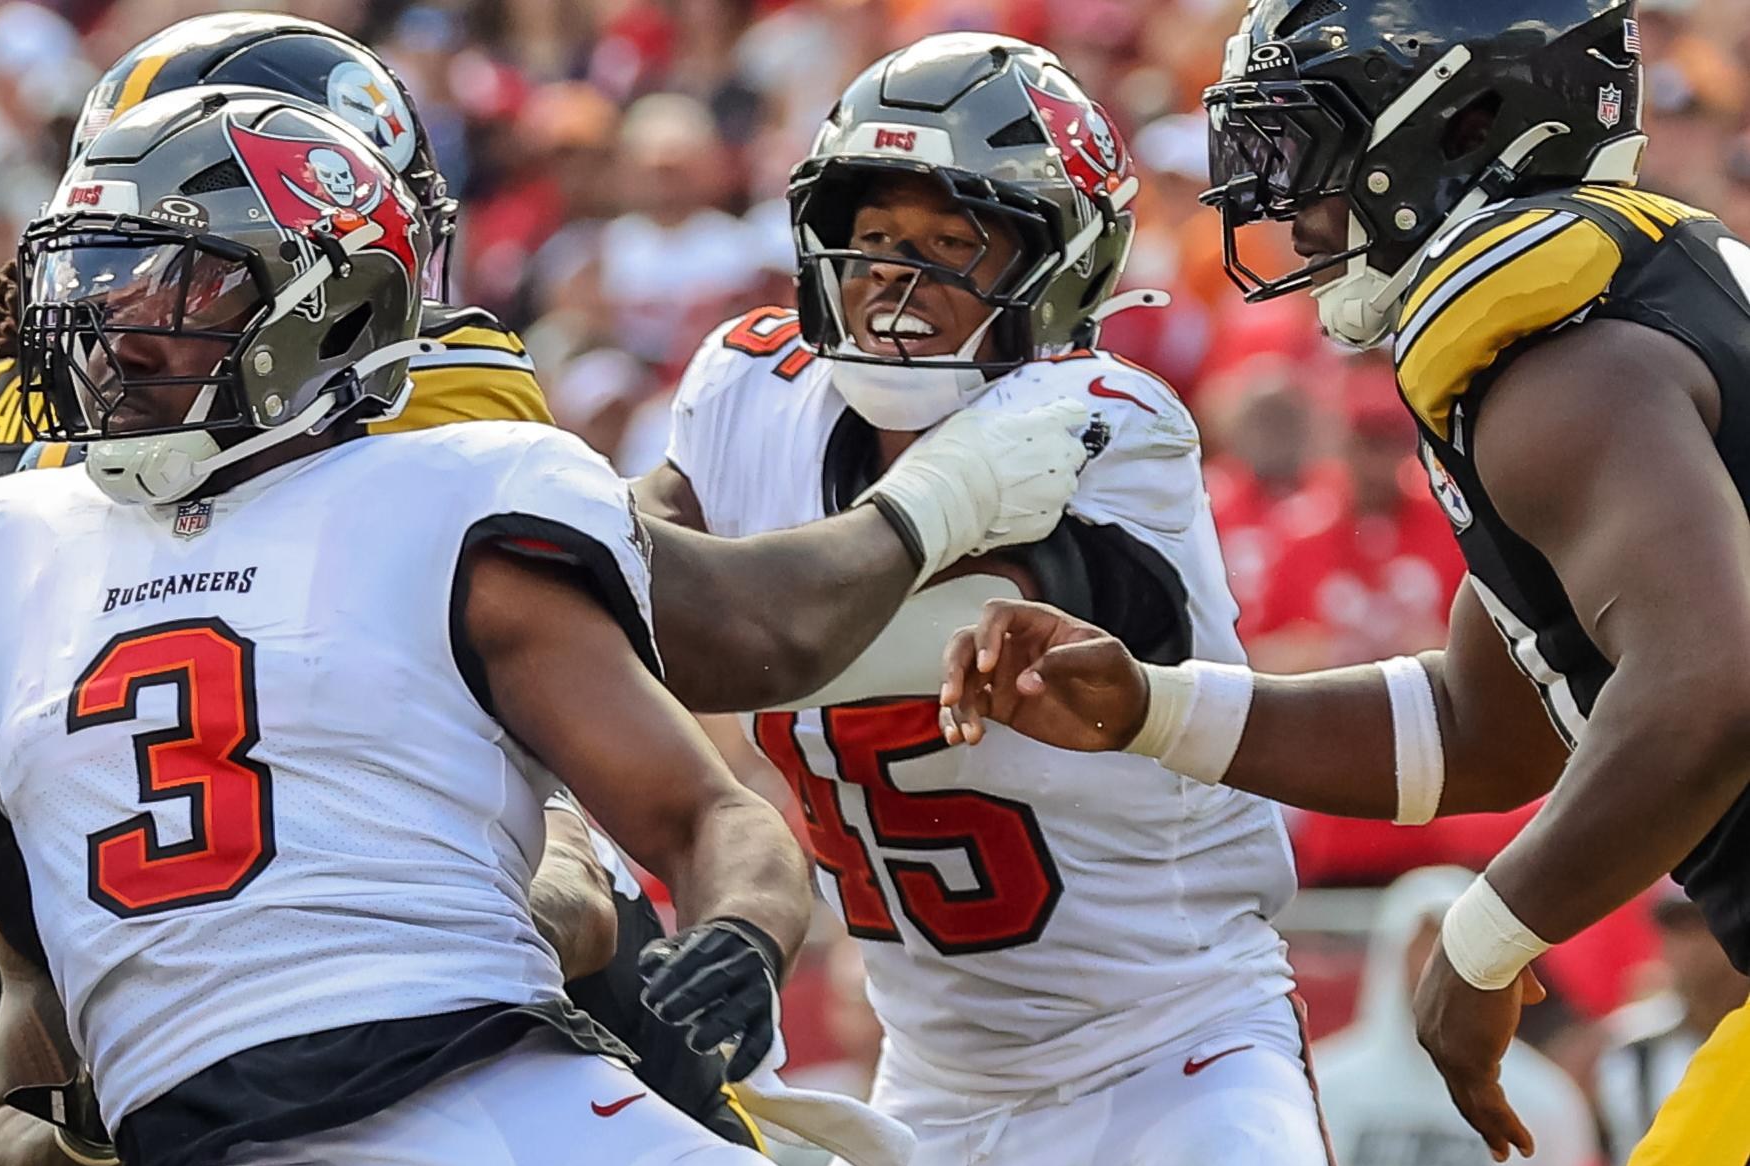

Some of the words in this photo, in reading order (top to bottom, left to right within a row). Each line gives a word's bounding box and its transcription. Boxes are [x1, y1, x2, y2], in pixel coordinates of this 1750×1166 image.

[1248, 57, 1290, 73] OAKLEY
[151, 210, 209, 229] OAKLEY
[177, 515, 207, 533] NFL
[102, 566, 259, 613] BUCCANEERS
[66, 615, 278, 920] 3
[754, 694, 1066, 957] 45
